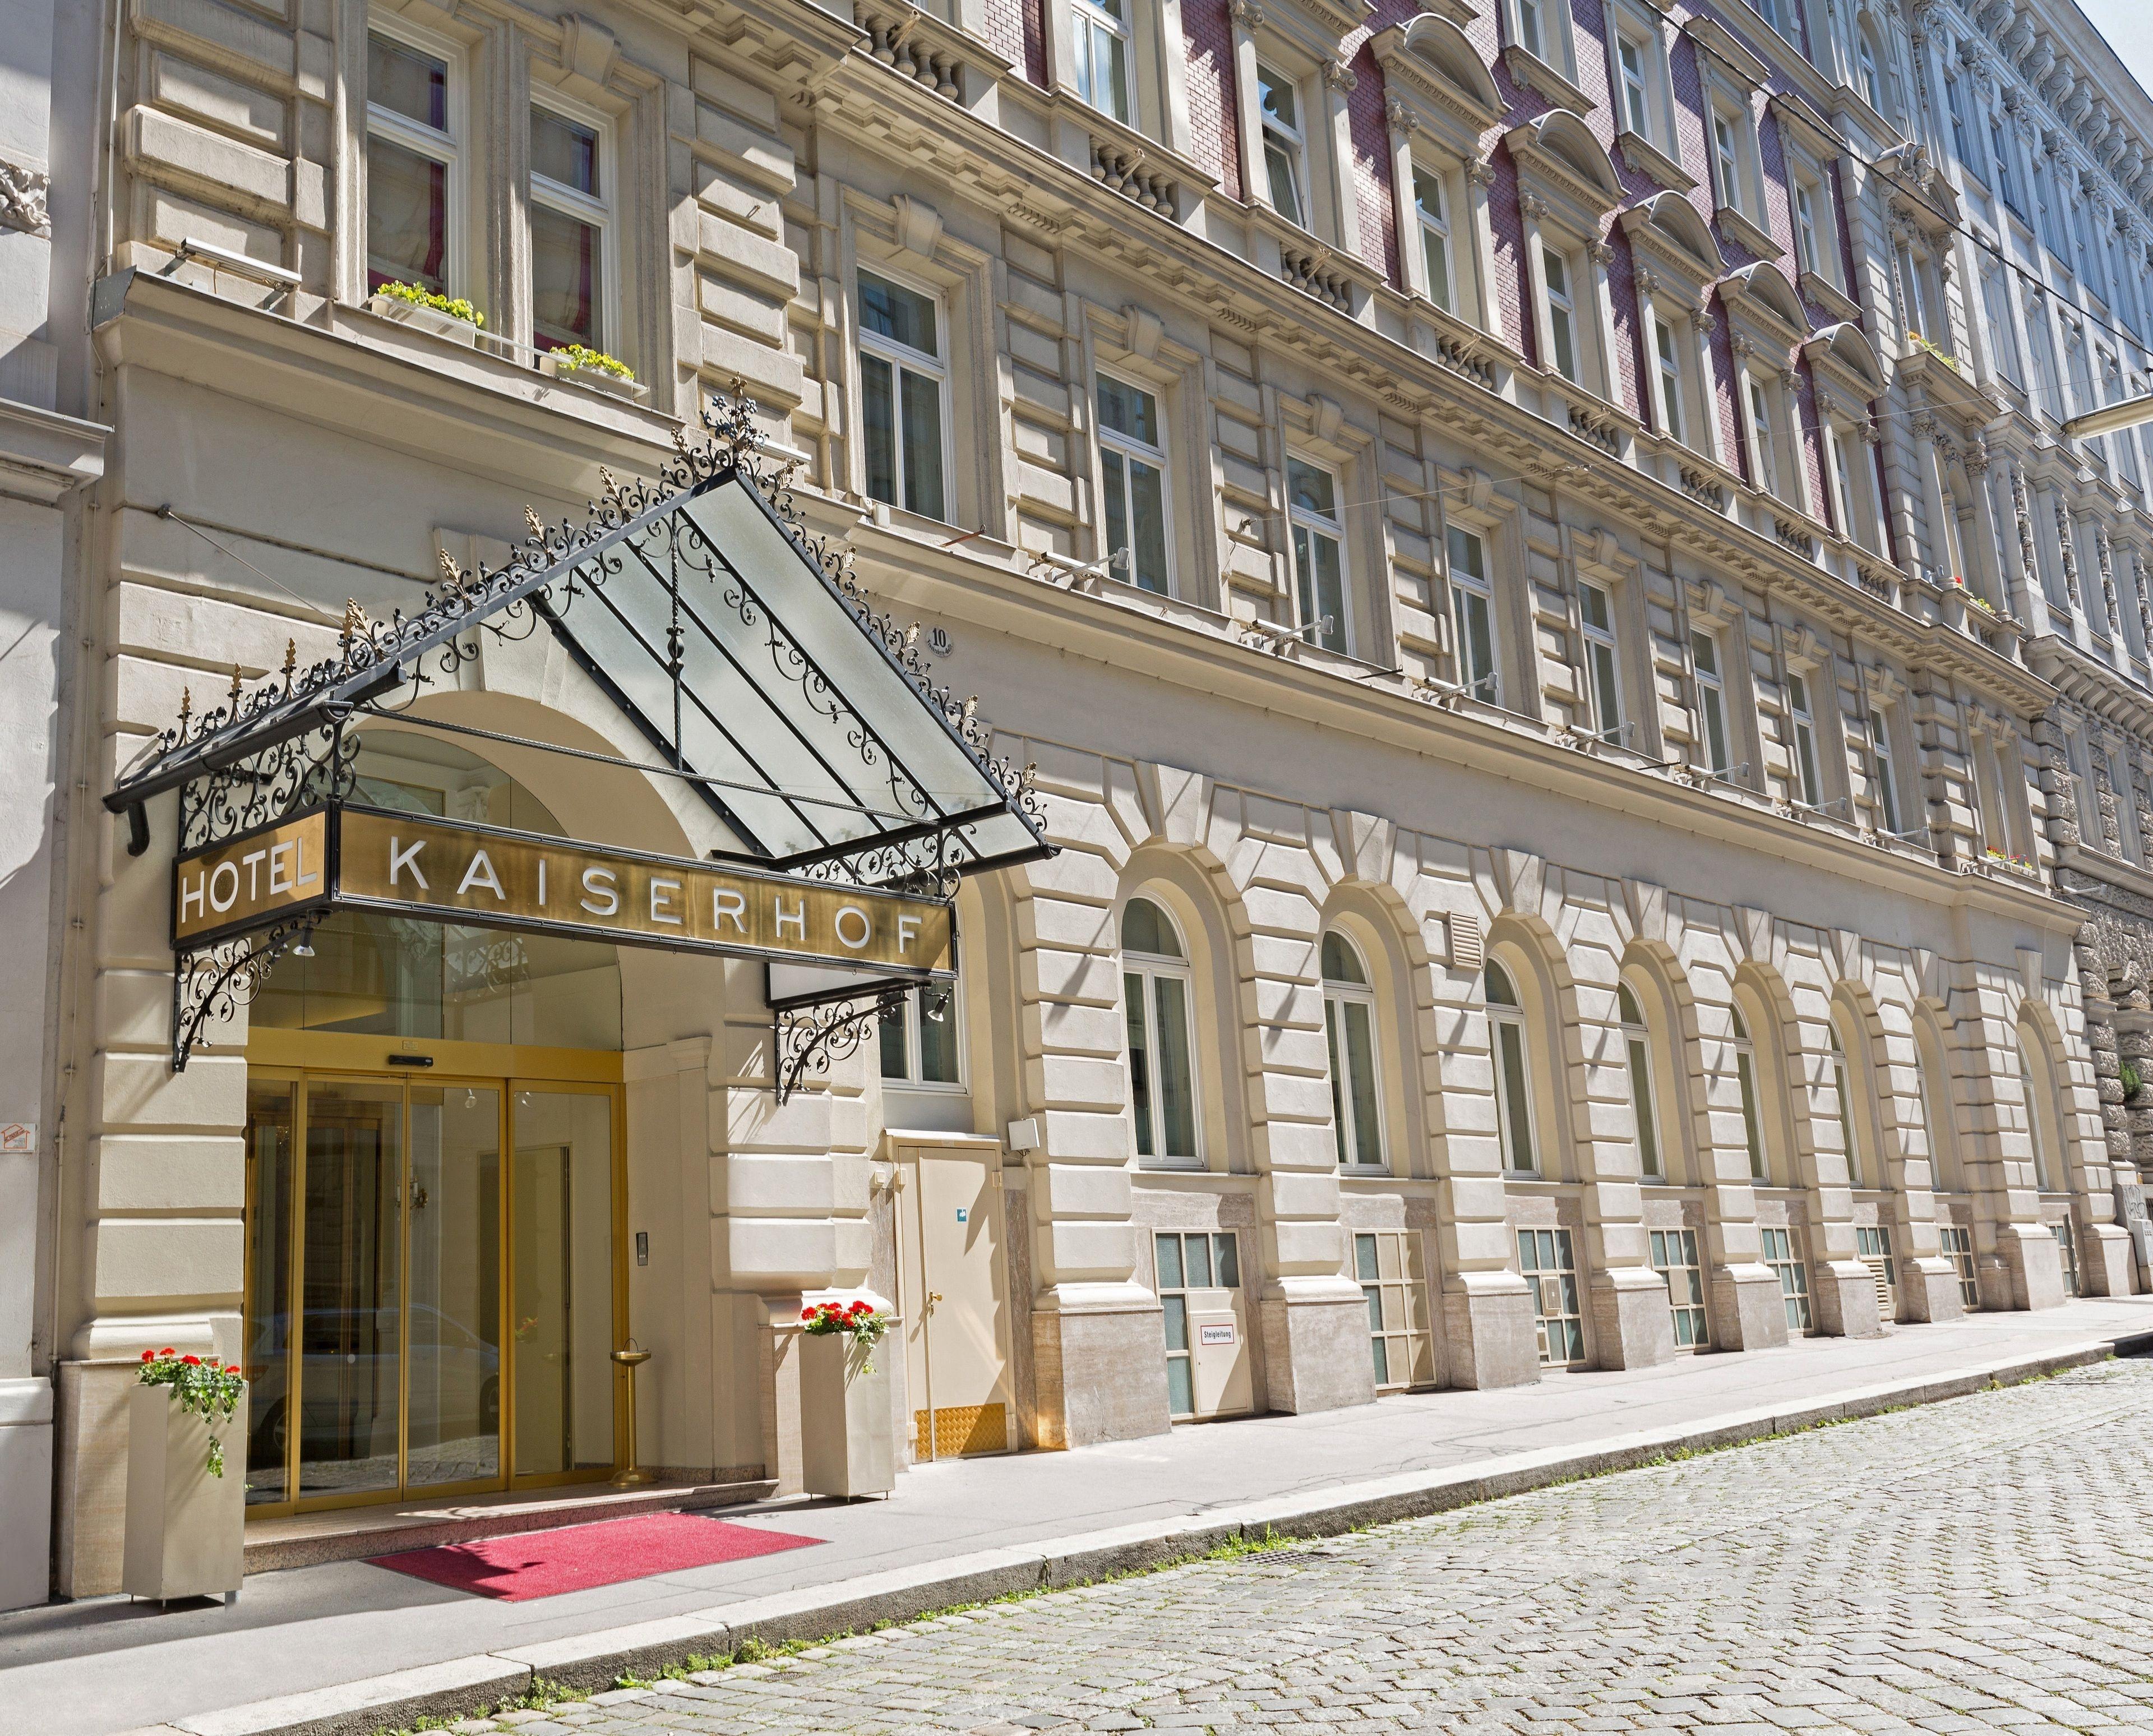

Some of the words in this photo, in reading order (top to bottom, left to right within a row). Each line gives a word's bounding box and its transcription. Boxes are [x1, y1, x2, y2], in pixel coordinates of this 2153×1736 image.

[932, 627, 946, 648] 10
[181, 837, 318, 923] HOTEL
[390, 835, 923, 954] KAISERHOF
[1204, 1331, 1231, 1340] Steigleitung
